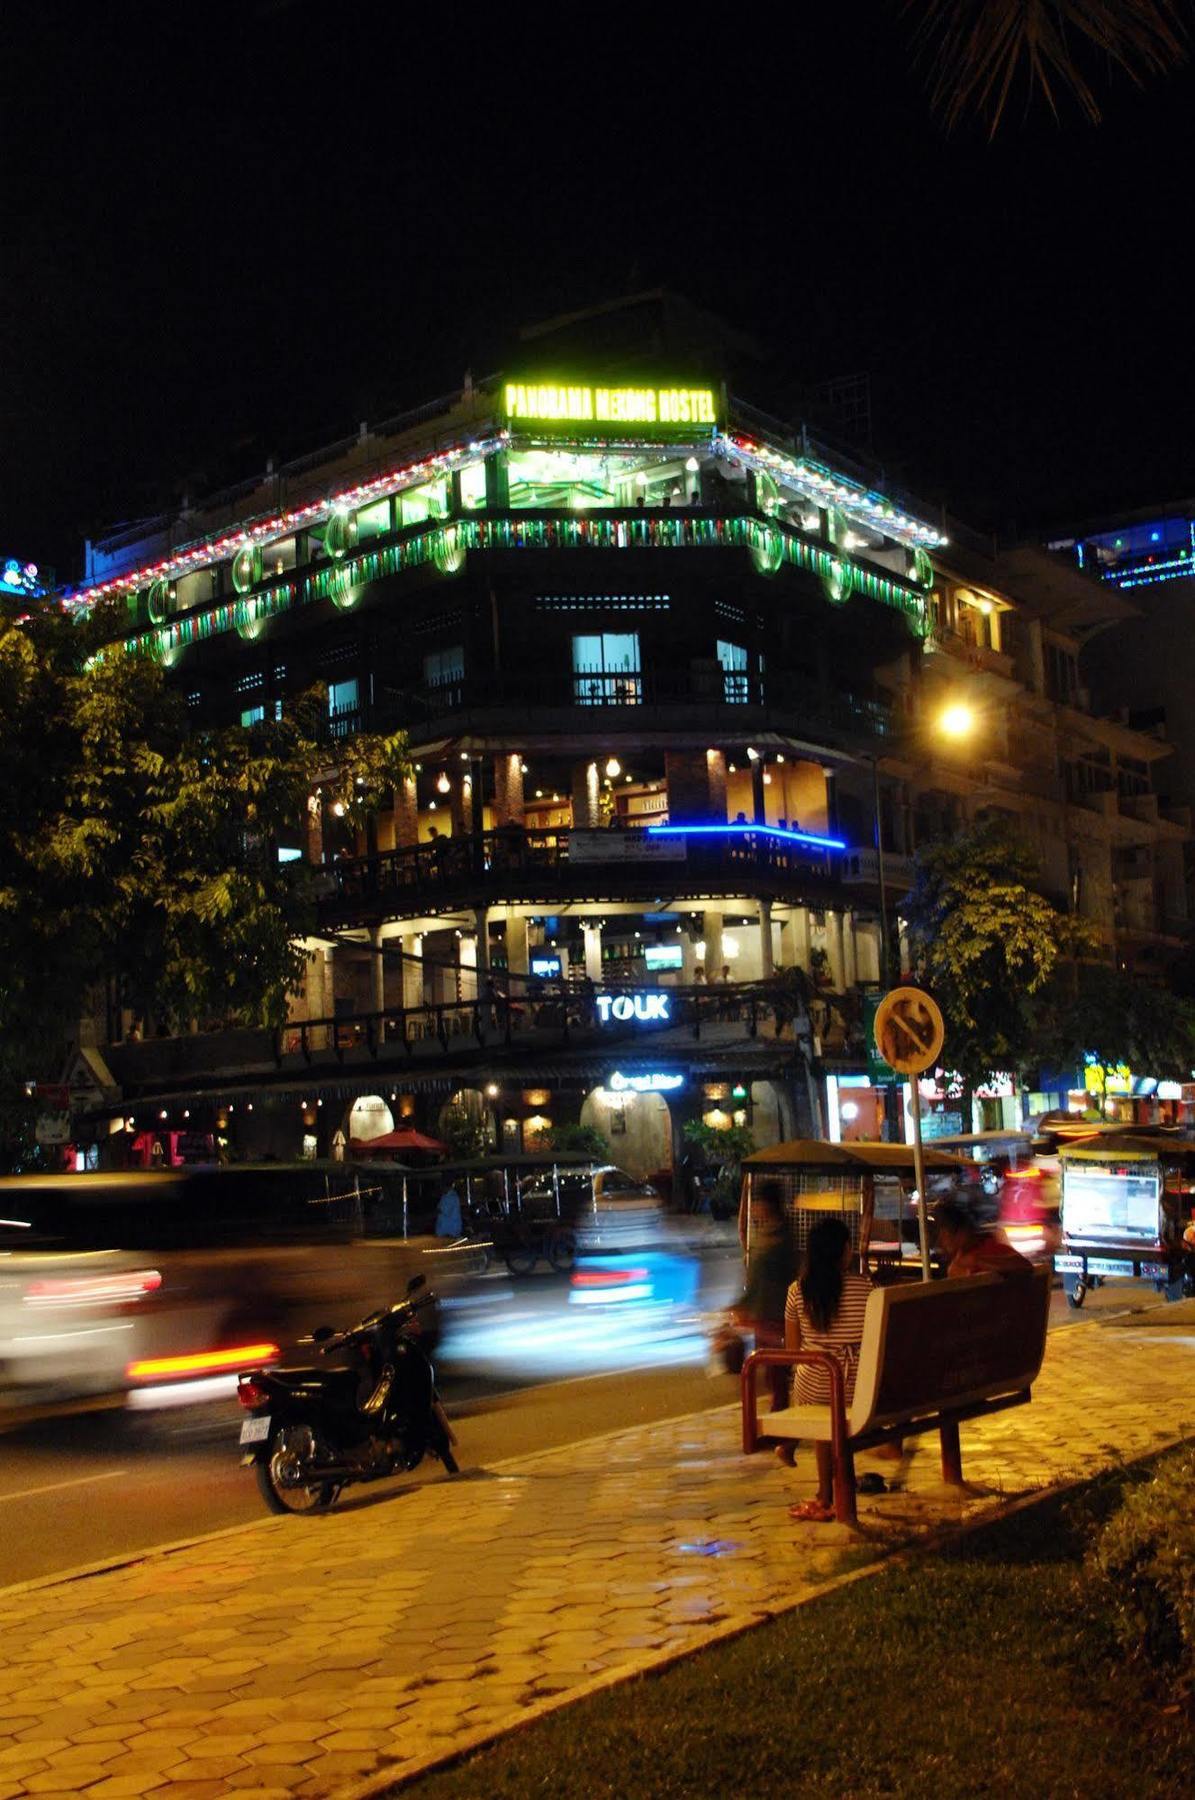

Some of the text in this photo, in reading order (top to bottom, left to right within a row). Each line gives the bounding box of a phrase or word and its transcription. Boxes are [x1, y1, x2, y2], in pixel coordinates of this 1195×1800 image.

[506, 384, 716, 423] PANORAMA MEKONG HOSTEL
[596, 994, 669, 1021] TOUK
